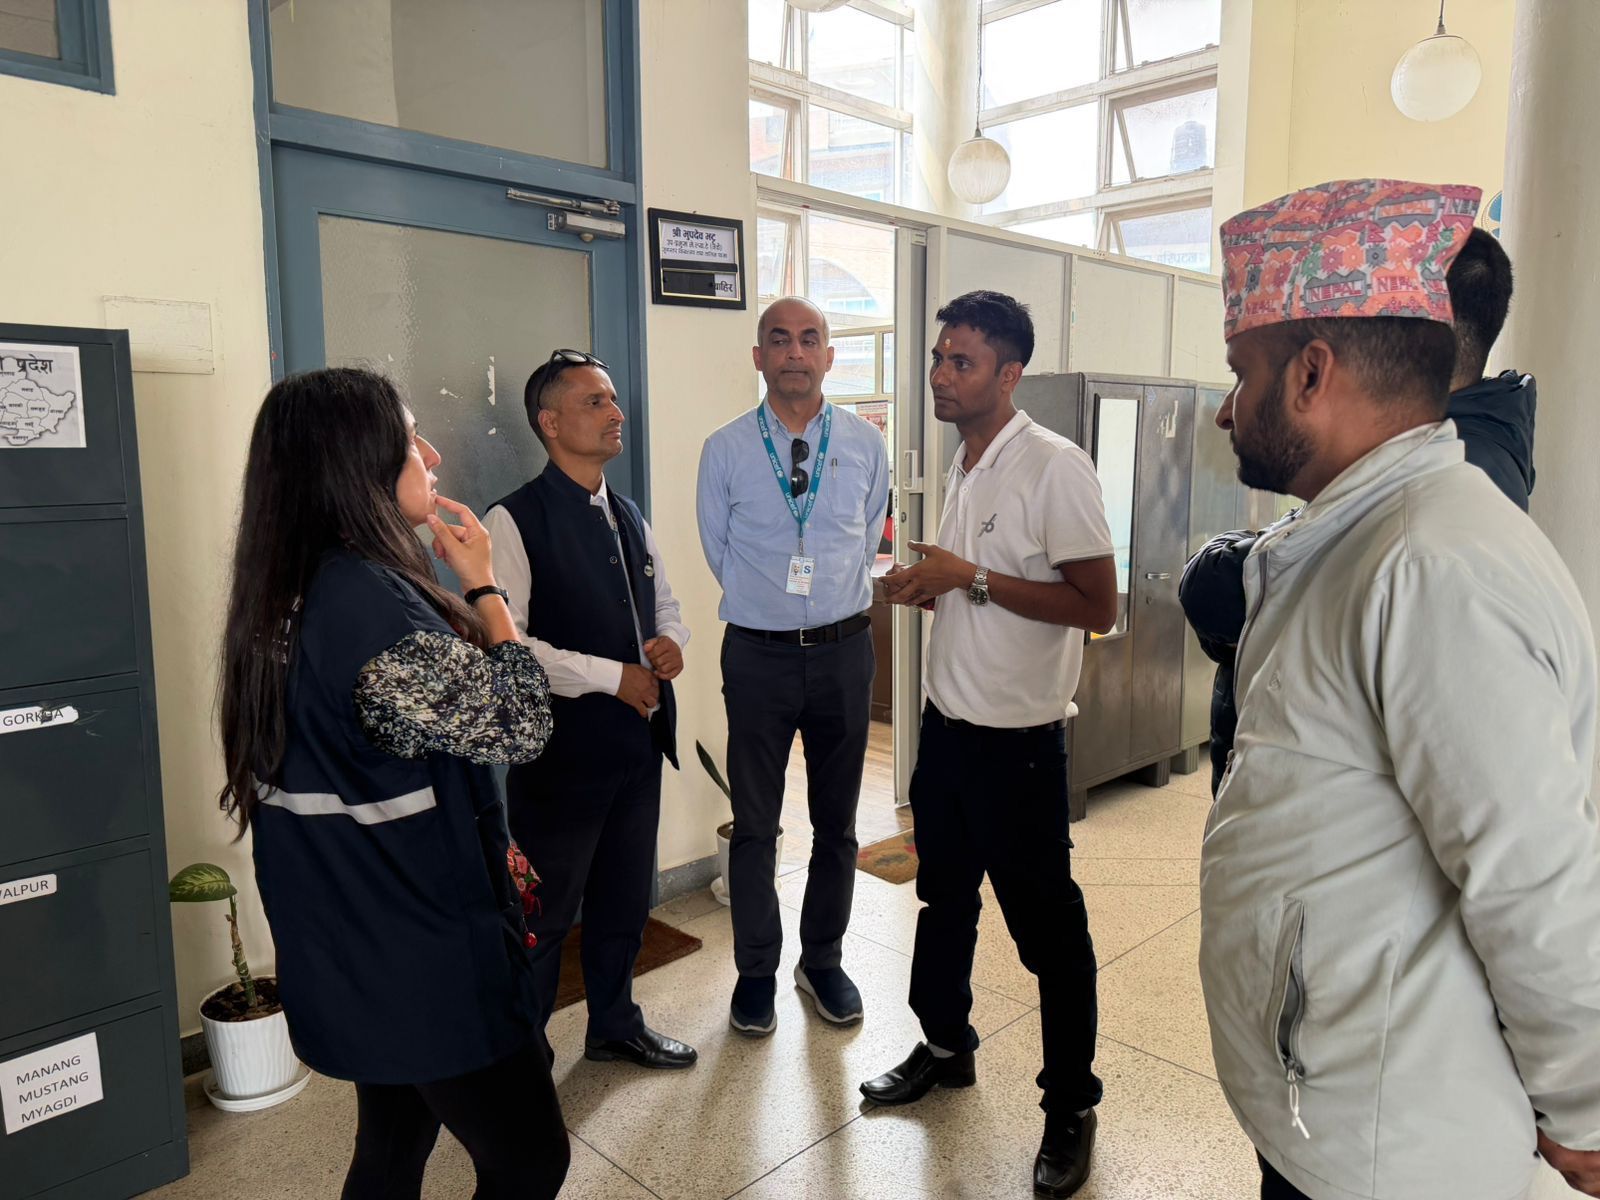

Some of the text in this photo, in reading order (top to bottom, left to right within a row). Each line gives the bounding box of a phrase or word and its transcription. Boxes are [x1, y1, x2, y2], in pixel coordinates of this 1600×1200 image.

[1380, 199, 1432, 216] NEPAL
[672, 226, 682, 238] श्री
[1309, 281, 1362, 301] NEPAL
[16, 354, 53, 374] प्रदेश
[769, 453, 780, 472] unicef
[816, 459, 824, 479] unicef
[803, 565, 812, 574] S
[3, 709, 63, 726] GORKA
[0, 880, 49, 899] ALPUR
[16, 1055, 81, 1085] MANANG
[19, 1072, 89, 1104] MUSTANG
[21, 1095, 77, 1123] MYAGDI
